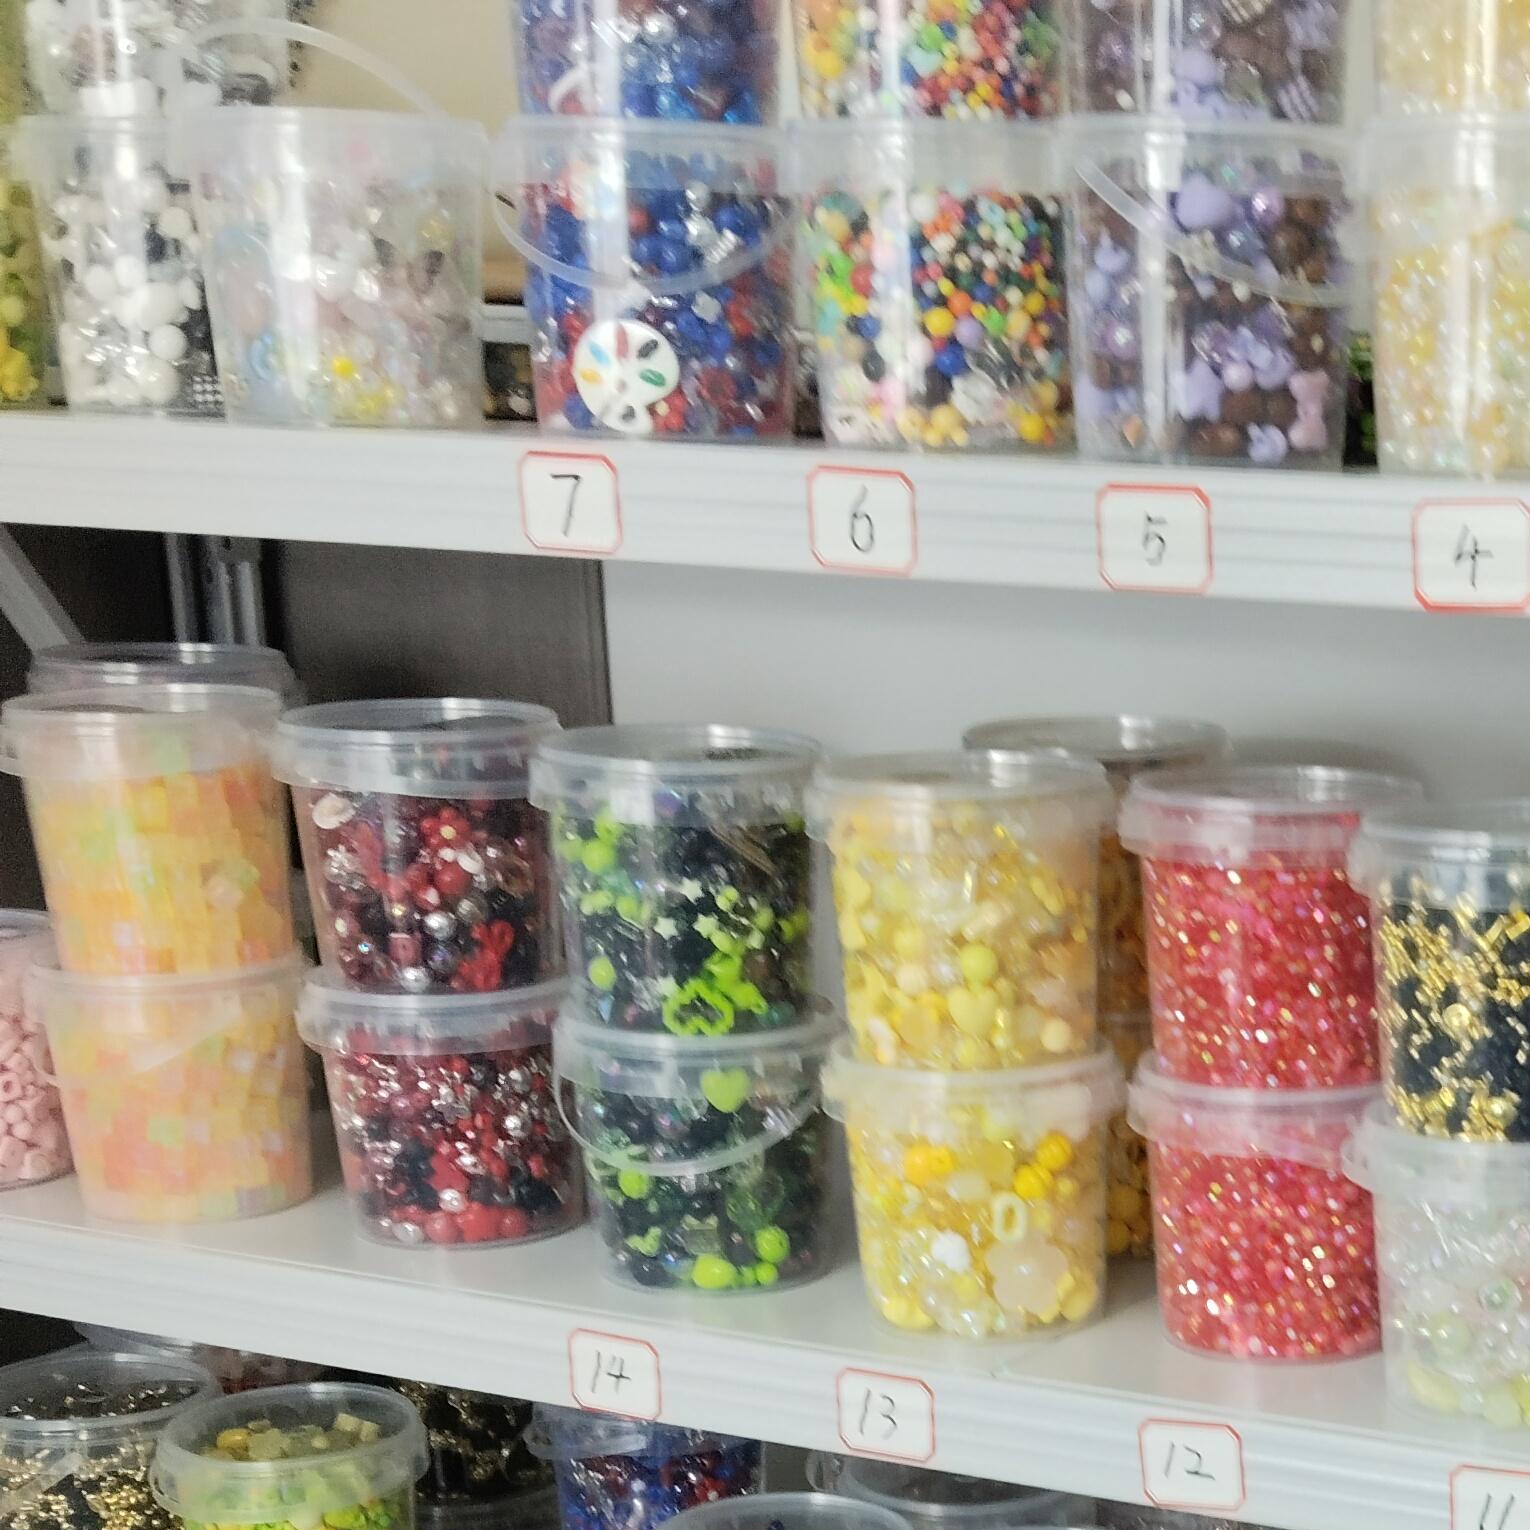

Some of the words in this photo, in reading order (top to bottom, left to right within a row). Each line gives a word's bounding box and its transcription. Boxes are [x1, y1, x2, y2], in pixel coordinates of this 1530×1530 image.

[550, 474, 582, 537] 7
[850, 484, 874, 553] 6
[1144, 511, 1167, 566] 5
[1454, 523, 1494, 590] 4
[592, 1350, 631, 1393] 14
[859, 1388, 898, 1440] 13
[1164, 1441, 1215, 1480] 12
